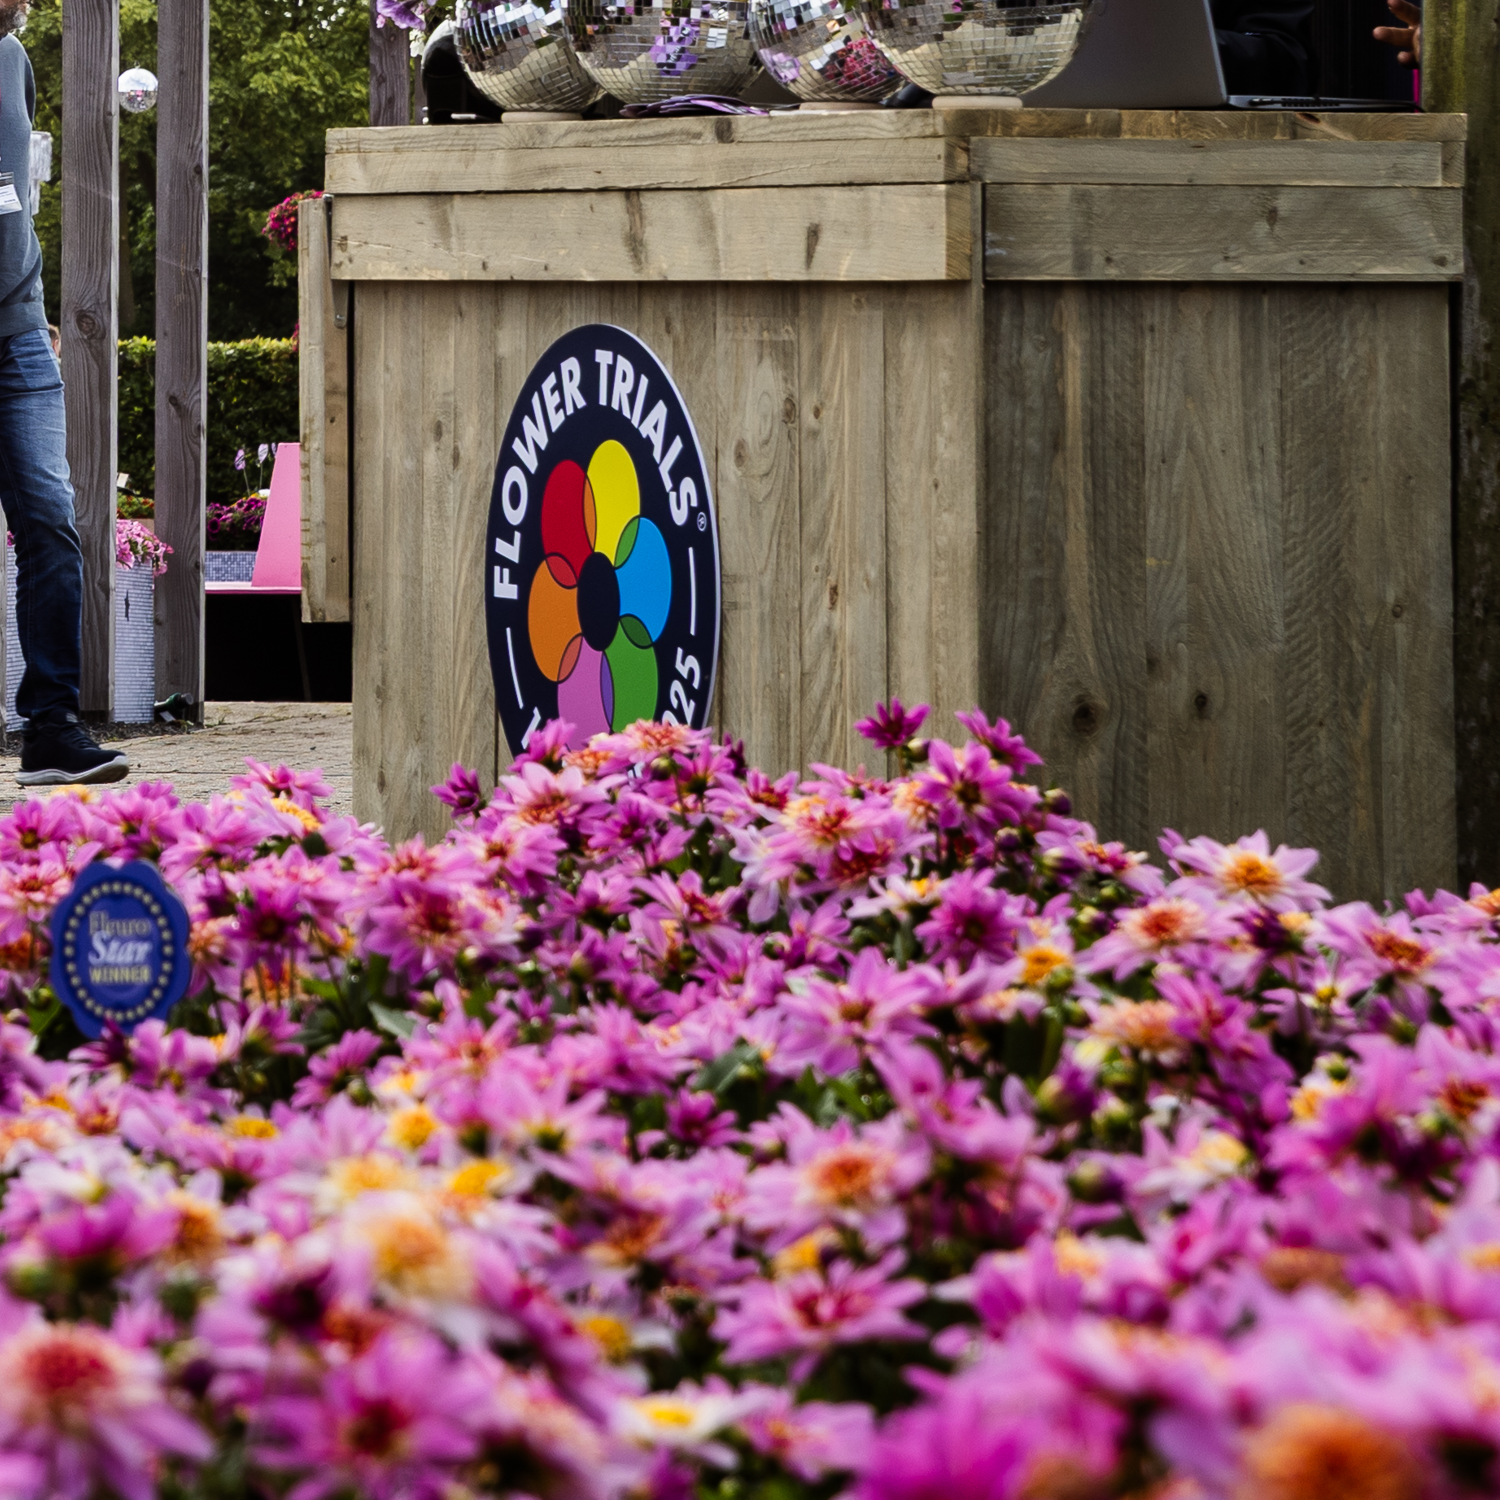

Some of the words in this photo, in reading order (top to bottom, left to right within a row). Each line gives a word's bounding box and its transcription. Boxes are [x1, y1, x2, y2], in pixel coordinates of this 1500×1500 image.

[494, 356, 586, 600] FLOWER
[595, 349, 698, 527] TRIALS
[88, 910, 150, 936] Fleuro
[88, 930, 152, 965] Star
[89, 965, 150, 984] WINNER
